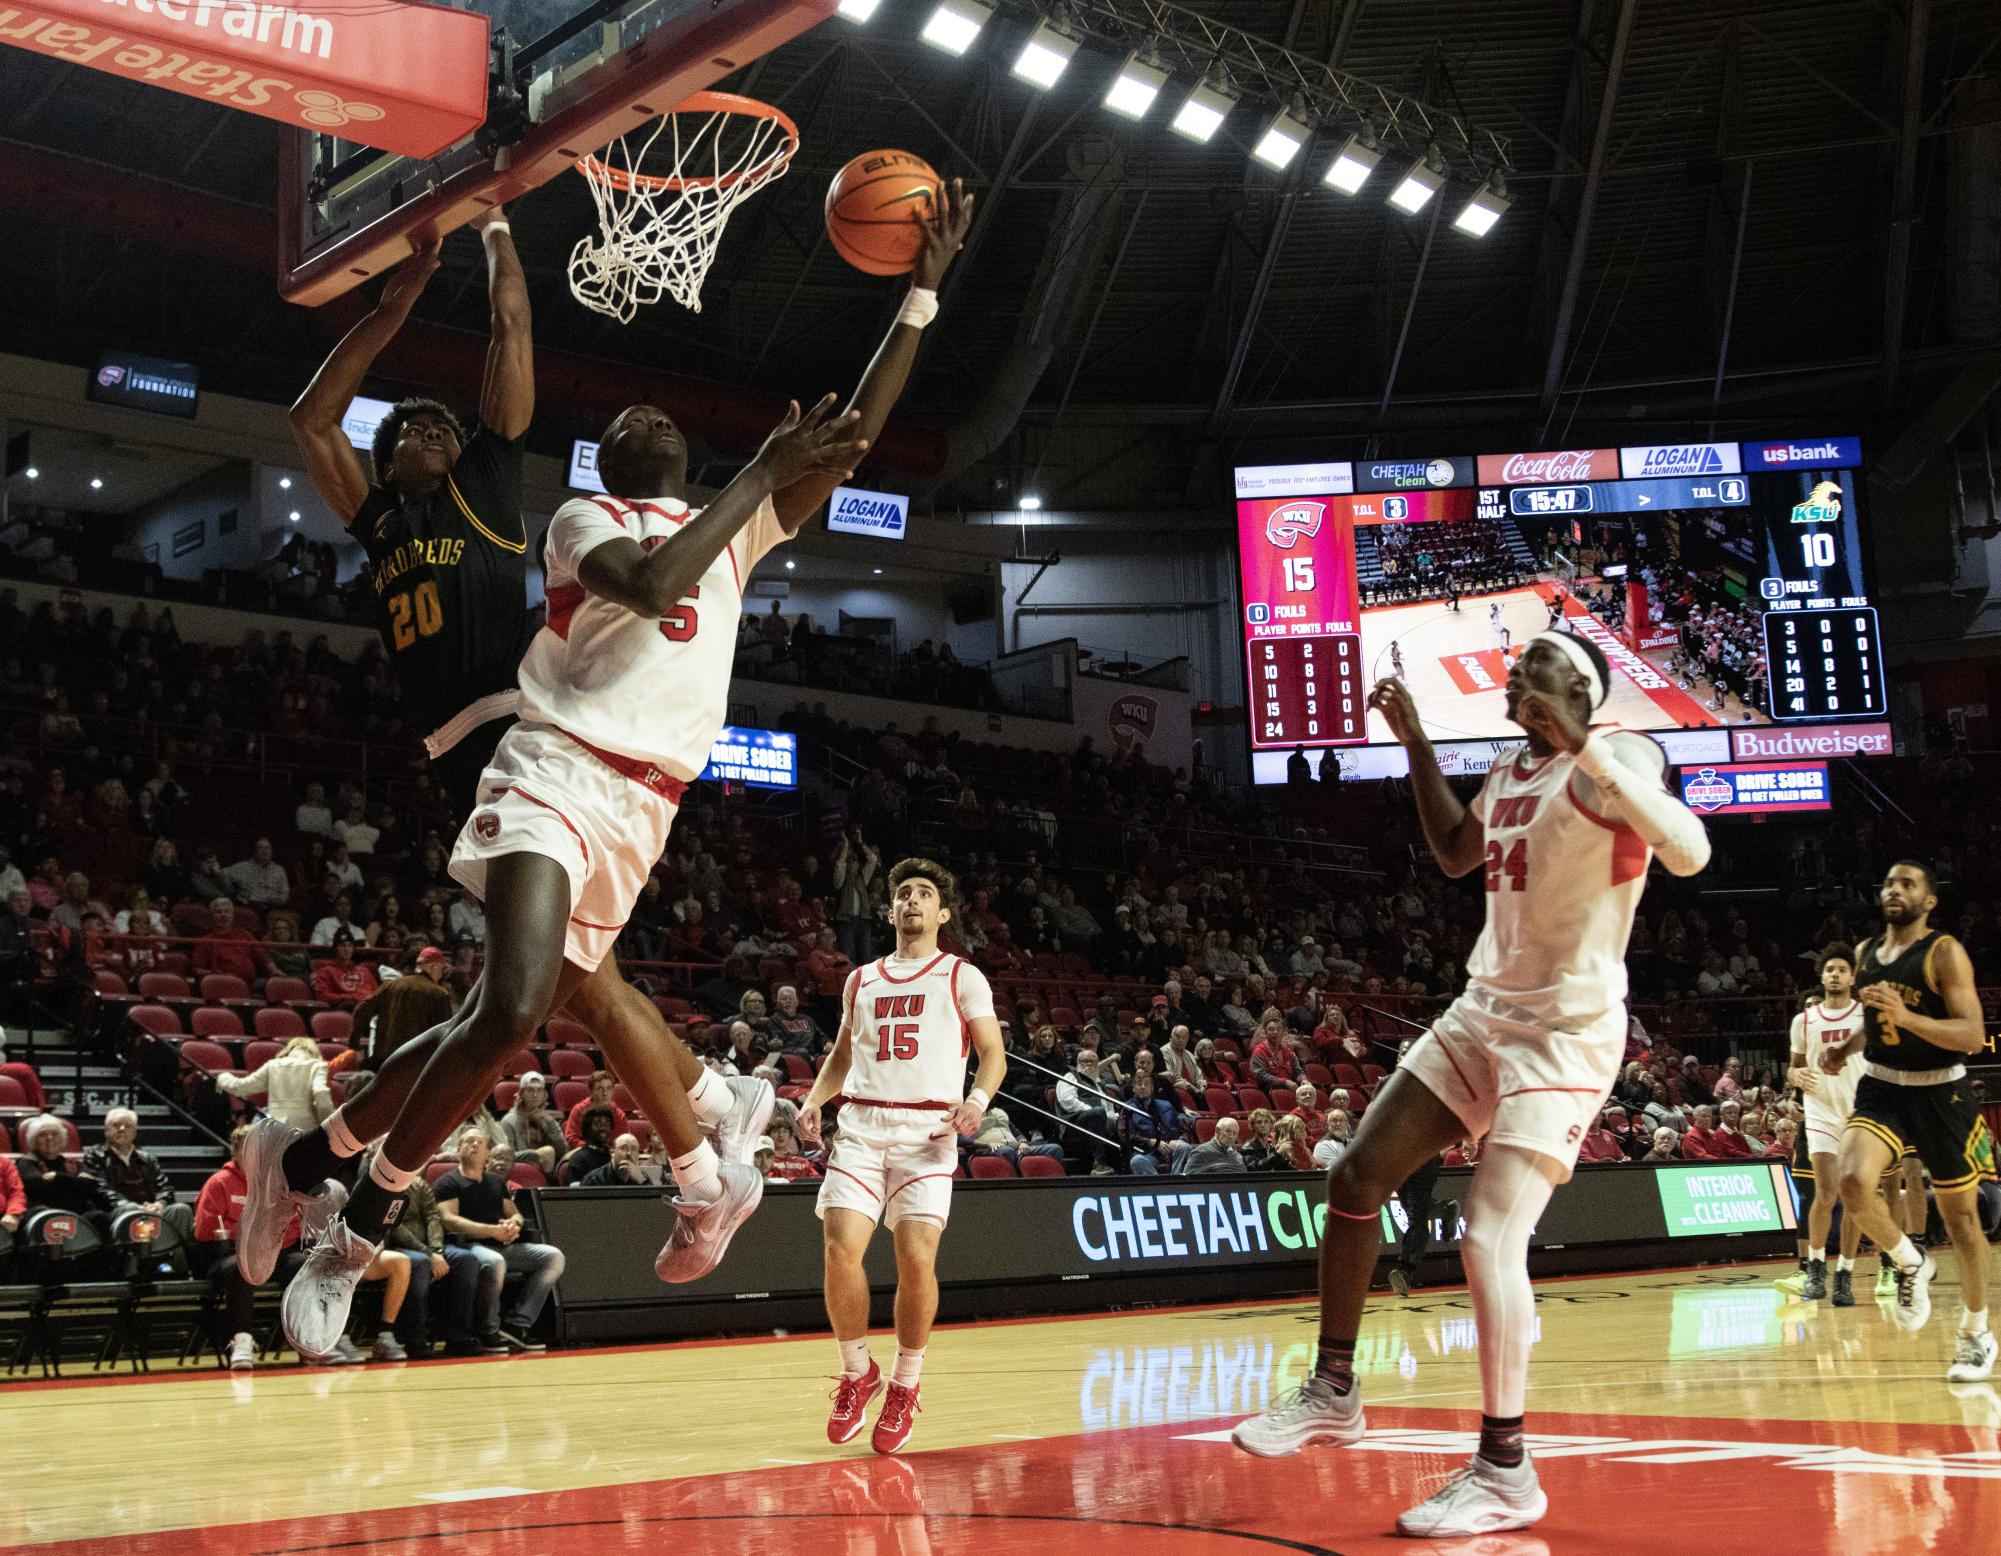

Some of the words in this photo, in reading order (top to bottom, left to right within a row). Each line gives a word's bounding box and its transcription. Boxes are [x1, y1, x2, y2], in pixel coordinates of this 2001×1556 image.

[863, 155, 926, 174] ELITE
[131, 377, 196, 399] FOUNDATION
[1643, 446, 1703, 466] LOGAN
[1371, 463, 1426, 479] CHEETAH
[1502, 450, 1597, 483] Coca-Cola
[1640, 465, 1697, 476] ALUMINUM
[1394, 476, 1426, 487] Clean
[1726, 482, 1740, 500] 4
[837, 497, 889, 518] LOGAN
[1389, 499, 1401, 518] 3
[1528, 490, 1576, 512] 15:47
[832, 514, 881, 527] ALUMINUM
[1281, 510, 1312, 524] WKU
[1477, 504, 1507, 520] HALF
[1790, 505, 1841, 524] KSU
[1800, 533, 1836, 567] 10
[1282, 557, 1316, 592] 15
[1768, 582, 1779, 596] 3
[1785, 580, 1819, 593] FOULS
[1254, 606, 1264, 620] 0
[1274, 604, 1307, 619] FOULS
[1770, 600, 1802, 610] PLAYER
[1806, 598, 1836, 608] POINTS
[1841, 597, 1868, 607] FOULS
[388, 580, 444, 652] 20
[659, 585, 700, 643] 5
[1254, 625, 1287, 636] PLAYER
[1291, 623, 1321, 634] POINTS
[1326, 621, 1352, 632] FOULS
[1785, 621, 1795, 635] 3
[1820, 619, 1831, 633] 0
[1855, 617, 1866, 632] 0
[1640, 634, 1679, 649] SPALDING
[1786, 640, 1797, 654] 5
[1822, 638, 1833, 653] 0
[1857, 637, 1868, 651] 0
[1265, 645, 1274, 660] 5
[1303, 643, 1313, 658] 2
[1339, 642, 1348, 656] 0
[1264, 665, 1278, 680] 10
[1305, 663, 1314, 677] 8
[1340, 661, 1349, 676] 0
[1785, 659, 1801, 673] 14
[1824, 658, 1835, 672] 8
[1861, 656, 1868, 670] 1
[1267, 684, 1277, 698] 11
[1306, 682, 1316, 696] 0
[1341, 680, 1351, 695] 0
[1785, 678, 1805, 692] 20
[1826, 676, 1837, 690] 2
[1863, 675, 1870, 689] 1
[1266, 702, 1280, 717] 15
[1307, 700, 1317, 715] 3
[1342, 698, 1352, 713] 0
[1790, 697, 1805, 711] 41
[1828, 696, 1839, 710] 0
[1865, 694, 1872, 708] 1
[1121, 703, 1148, 722] WKU
[1265, 722, 1284, 737] 24
[1309, 720, 1318, 735] 0
[1344, 719, 1353, 733] 0
[1668, 741, 1725, 755] MORTGAGE
[1736, 730, 1888, 758] Budweiser
[710, 743, 750, 766] DRIVE
[750, 747, 792, 770] SOBER
[1436, 750, 1460, 765] airie
[770, 770, 792, 785] OVER
[1736, 773, 1777, 790] DRIVE
[1777, 771, 1823, 789] SOBER
[1687, 787, 1708, 796] DRIVE
[1708, 786, 1731, 795] SOBER
[1751, 791, 1768, 802] GET
[1769, 790, 1800, 802] PULLED
[1800, 789, 1823, 800] OVER
[1486, 838, 1529, 892] 24
[874, 994, 926, 1020] WKU
[1876, 1012, 1901, 1046] 3
[876, 1024, 920, 1062] 15
[1685, 1173, 1757, 1198] INTERIOR
[1695, 1200, 1771, 1225] CLEANING
[1072, 1190, 1268, 1261] CHEETAH
